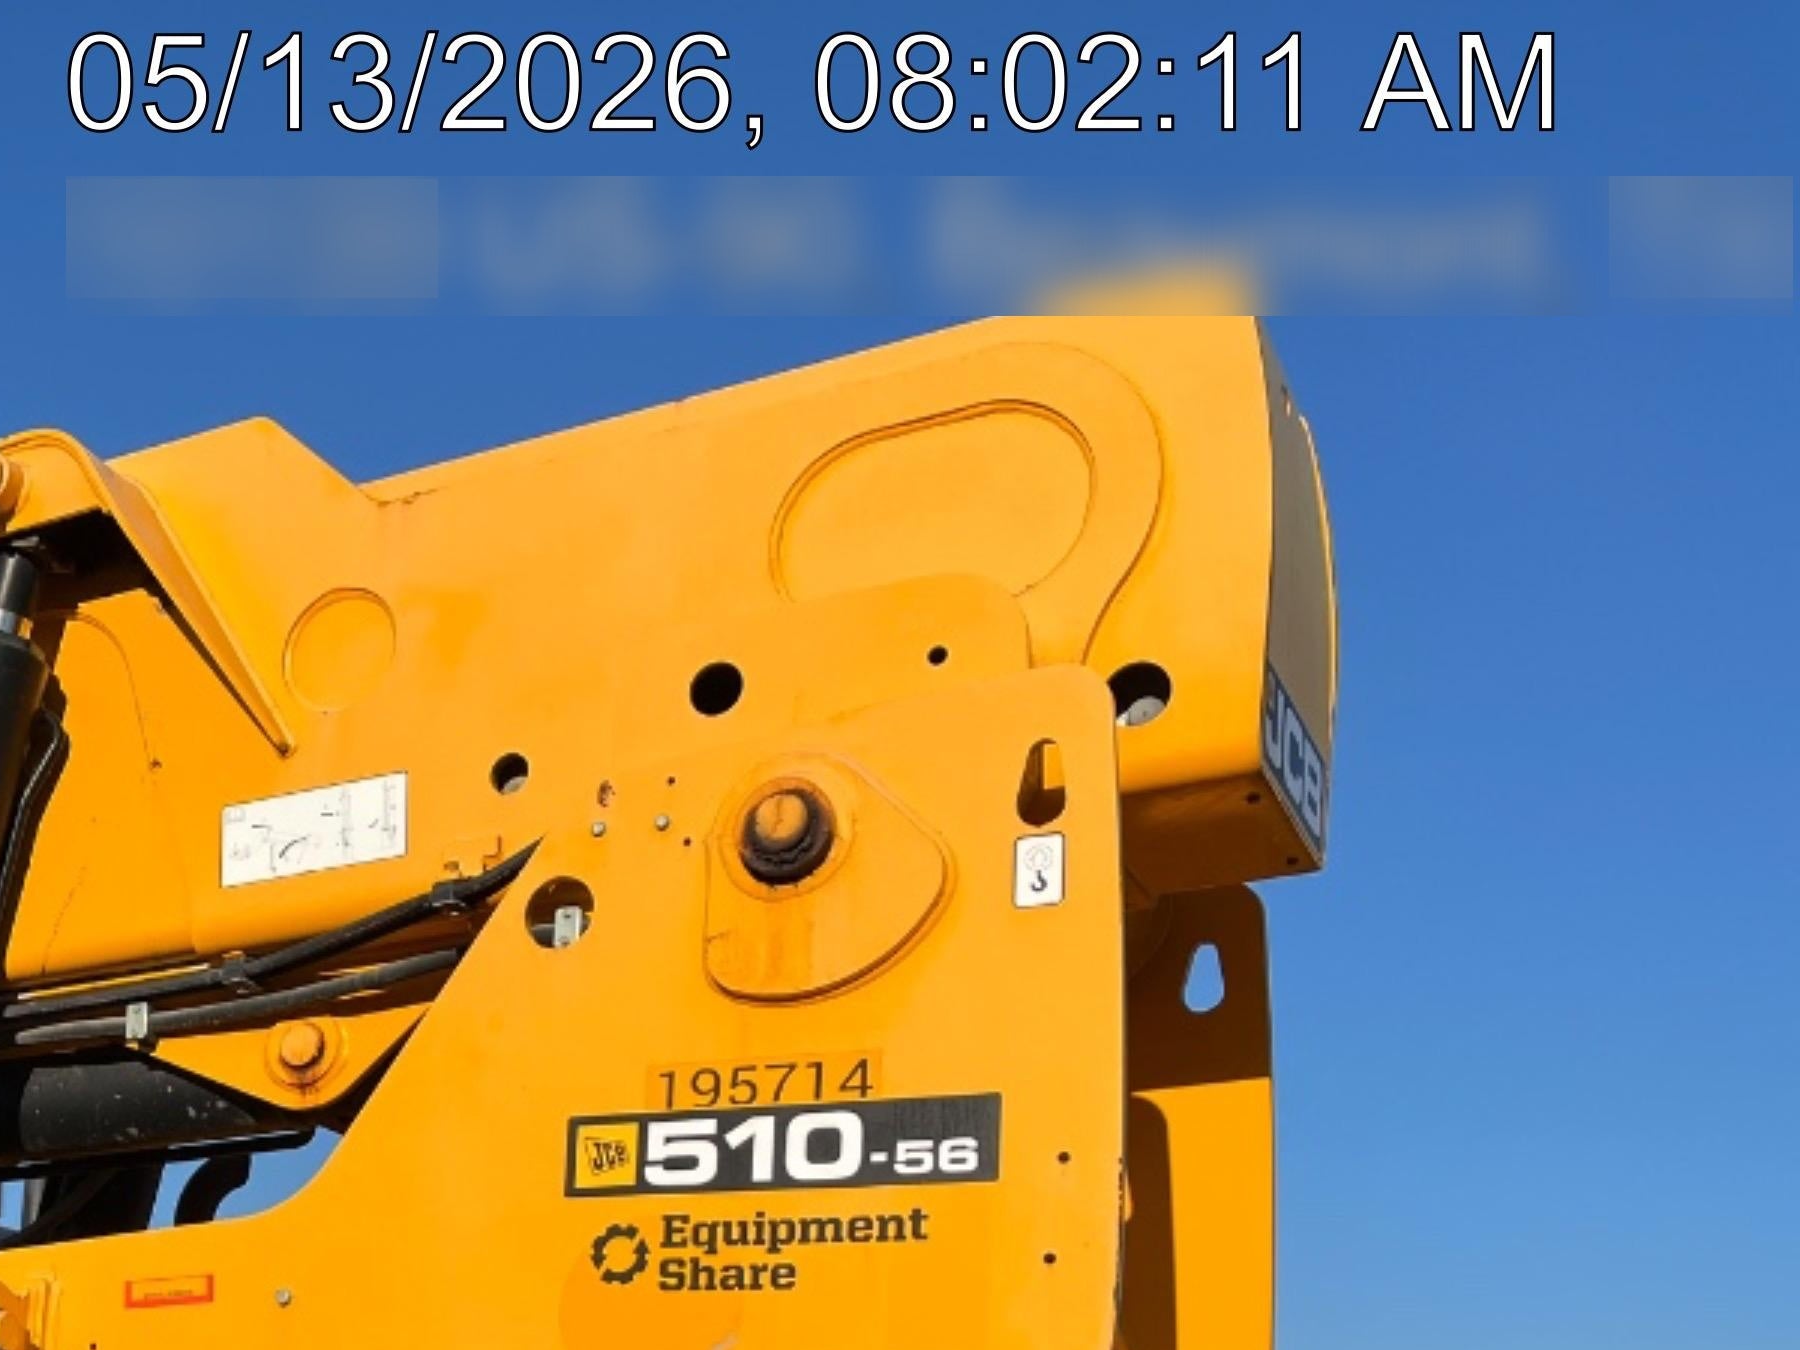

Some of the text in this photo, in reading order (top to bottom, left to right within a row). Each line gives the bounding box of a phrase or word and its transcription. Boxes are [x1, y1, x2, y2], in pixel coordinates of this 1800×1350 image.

[1265, 684, 1322, 840] JCB
[658, 1057, 874, 1111] 195714
[642, 1109, 980, 1187] 510-56
[659, 1207, 930, 1256] Equipment
[658, 1257, 797, 1291] Share
